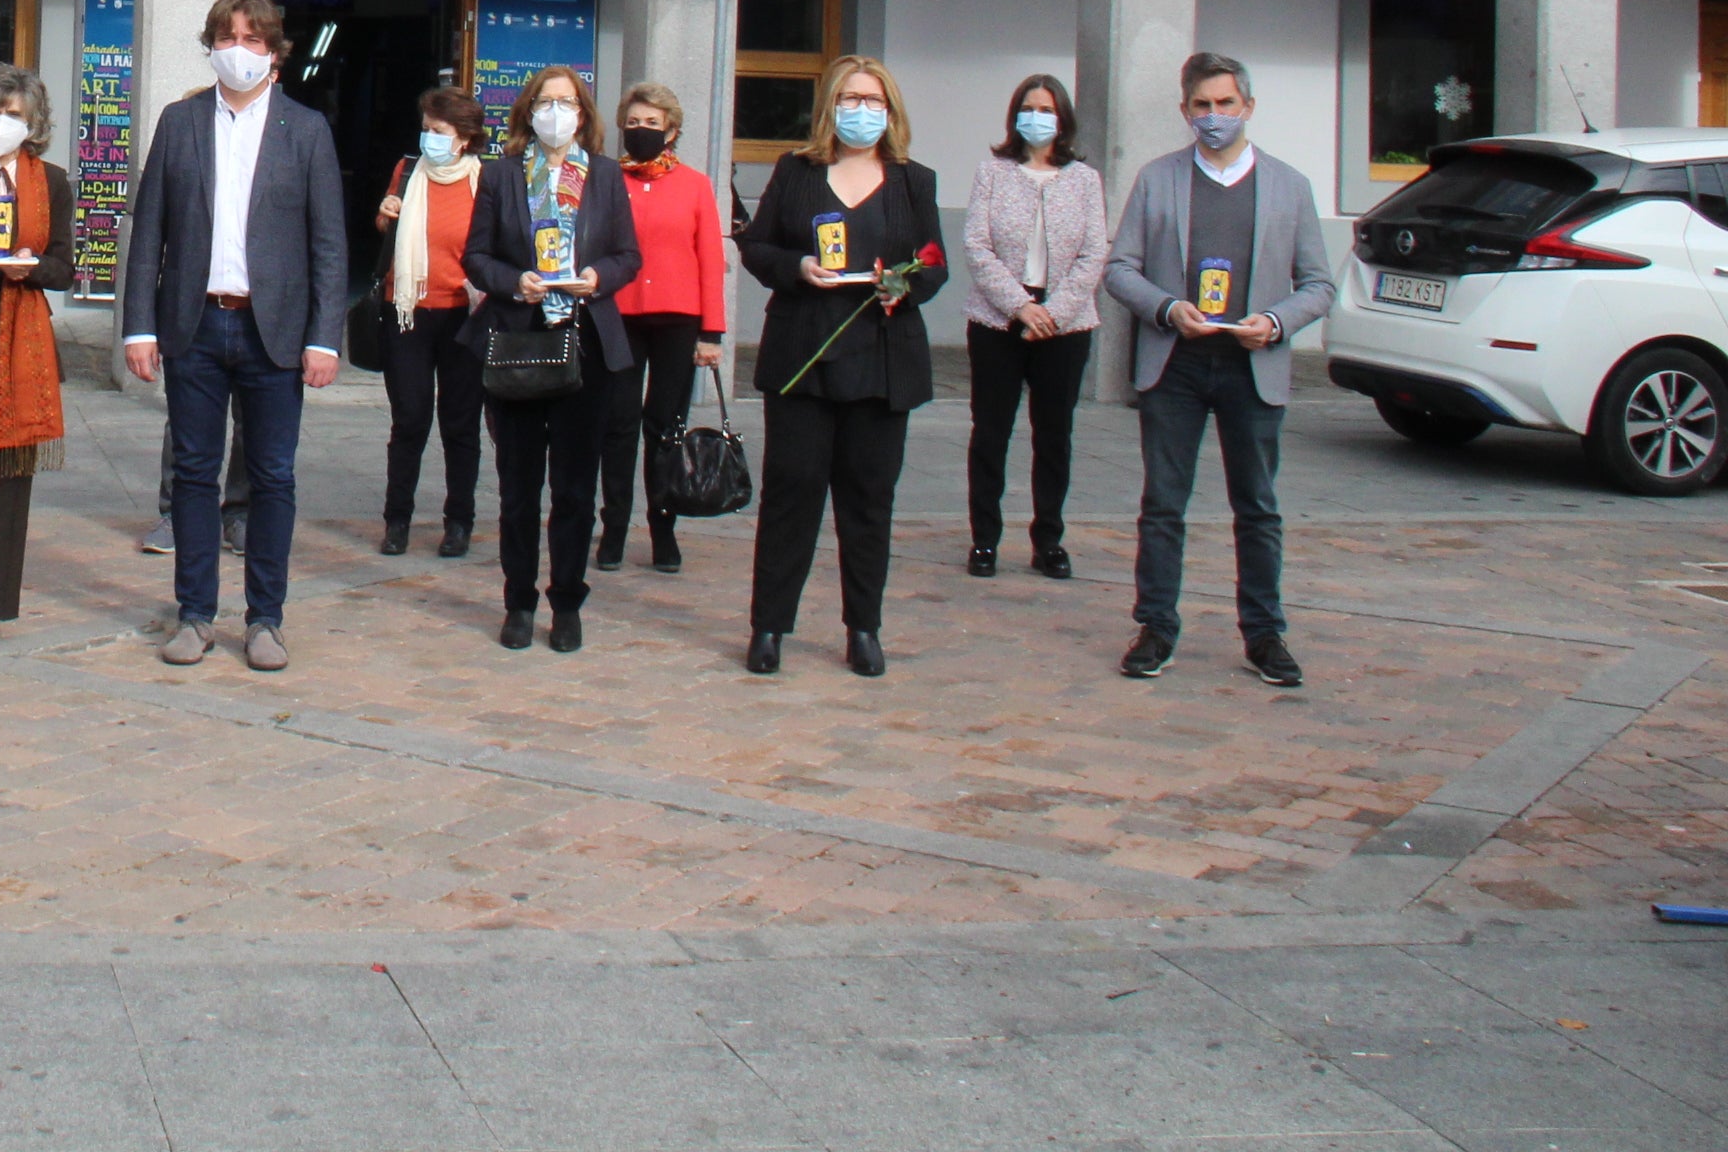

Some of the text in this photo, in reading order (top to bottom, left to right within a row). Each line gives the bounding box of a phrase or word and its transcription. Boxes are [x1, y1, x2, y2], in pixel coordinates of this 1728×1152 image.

[487, 74, 521, 87] I+D+I
[81, 161, 112, 169] ESPACIO
[81, 181, 116, 194] I+D+I
[1383, 276, 1441, 303] 1182 KST
